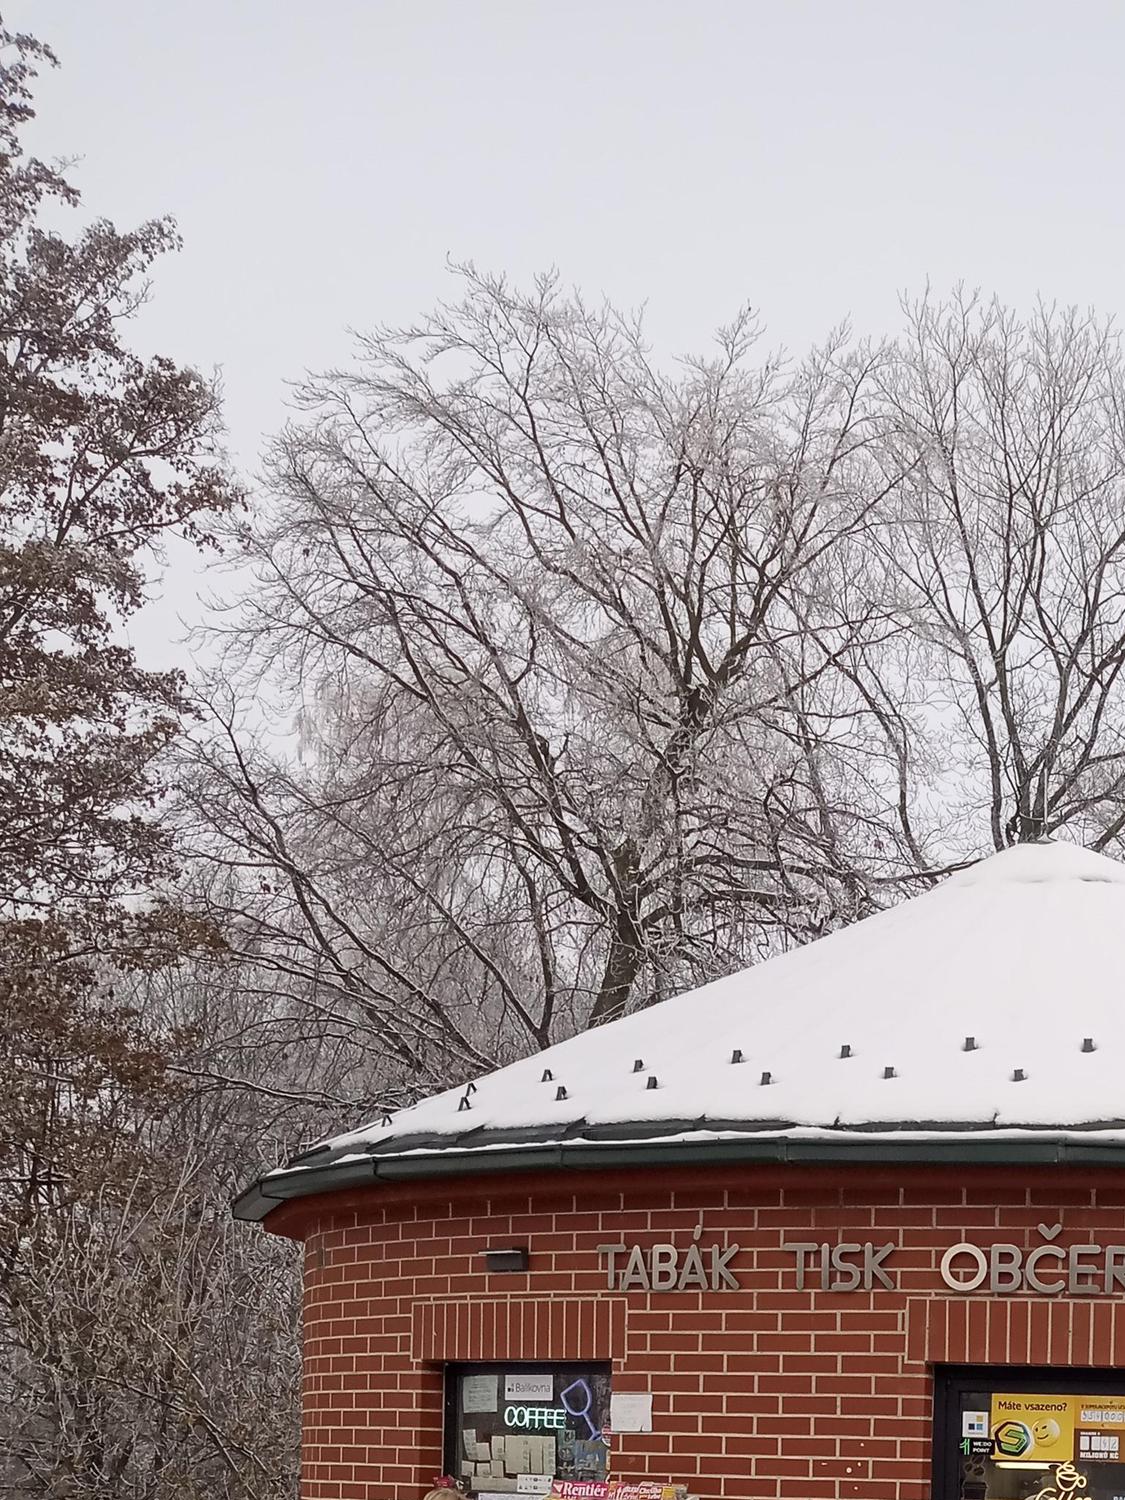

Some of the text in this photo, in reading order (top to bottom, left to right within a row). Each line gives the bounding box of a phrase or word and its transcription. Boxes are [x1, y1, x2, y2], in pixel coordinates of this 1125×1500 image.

[596, 1224, 740, 1291] TABÁK
[782, 1241, 896, 1291] TISK
[998, 1400, 1068, 1412] Máte vsazeno?
[504, 1406, 566, 1429] COFFEE
[562, 1483, 608, 1498] Rentiér
